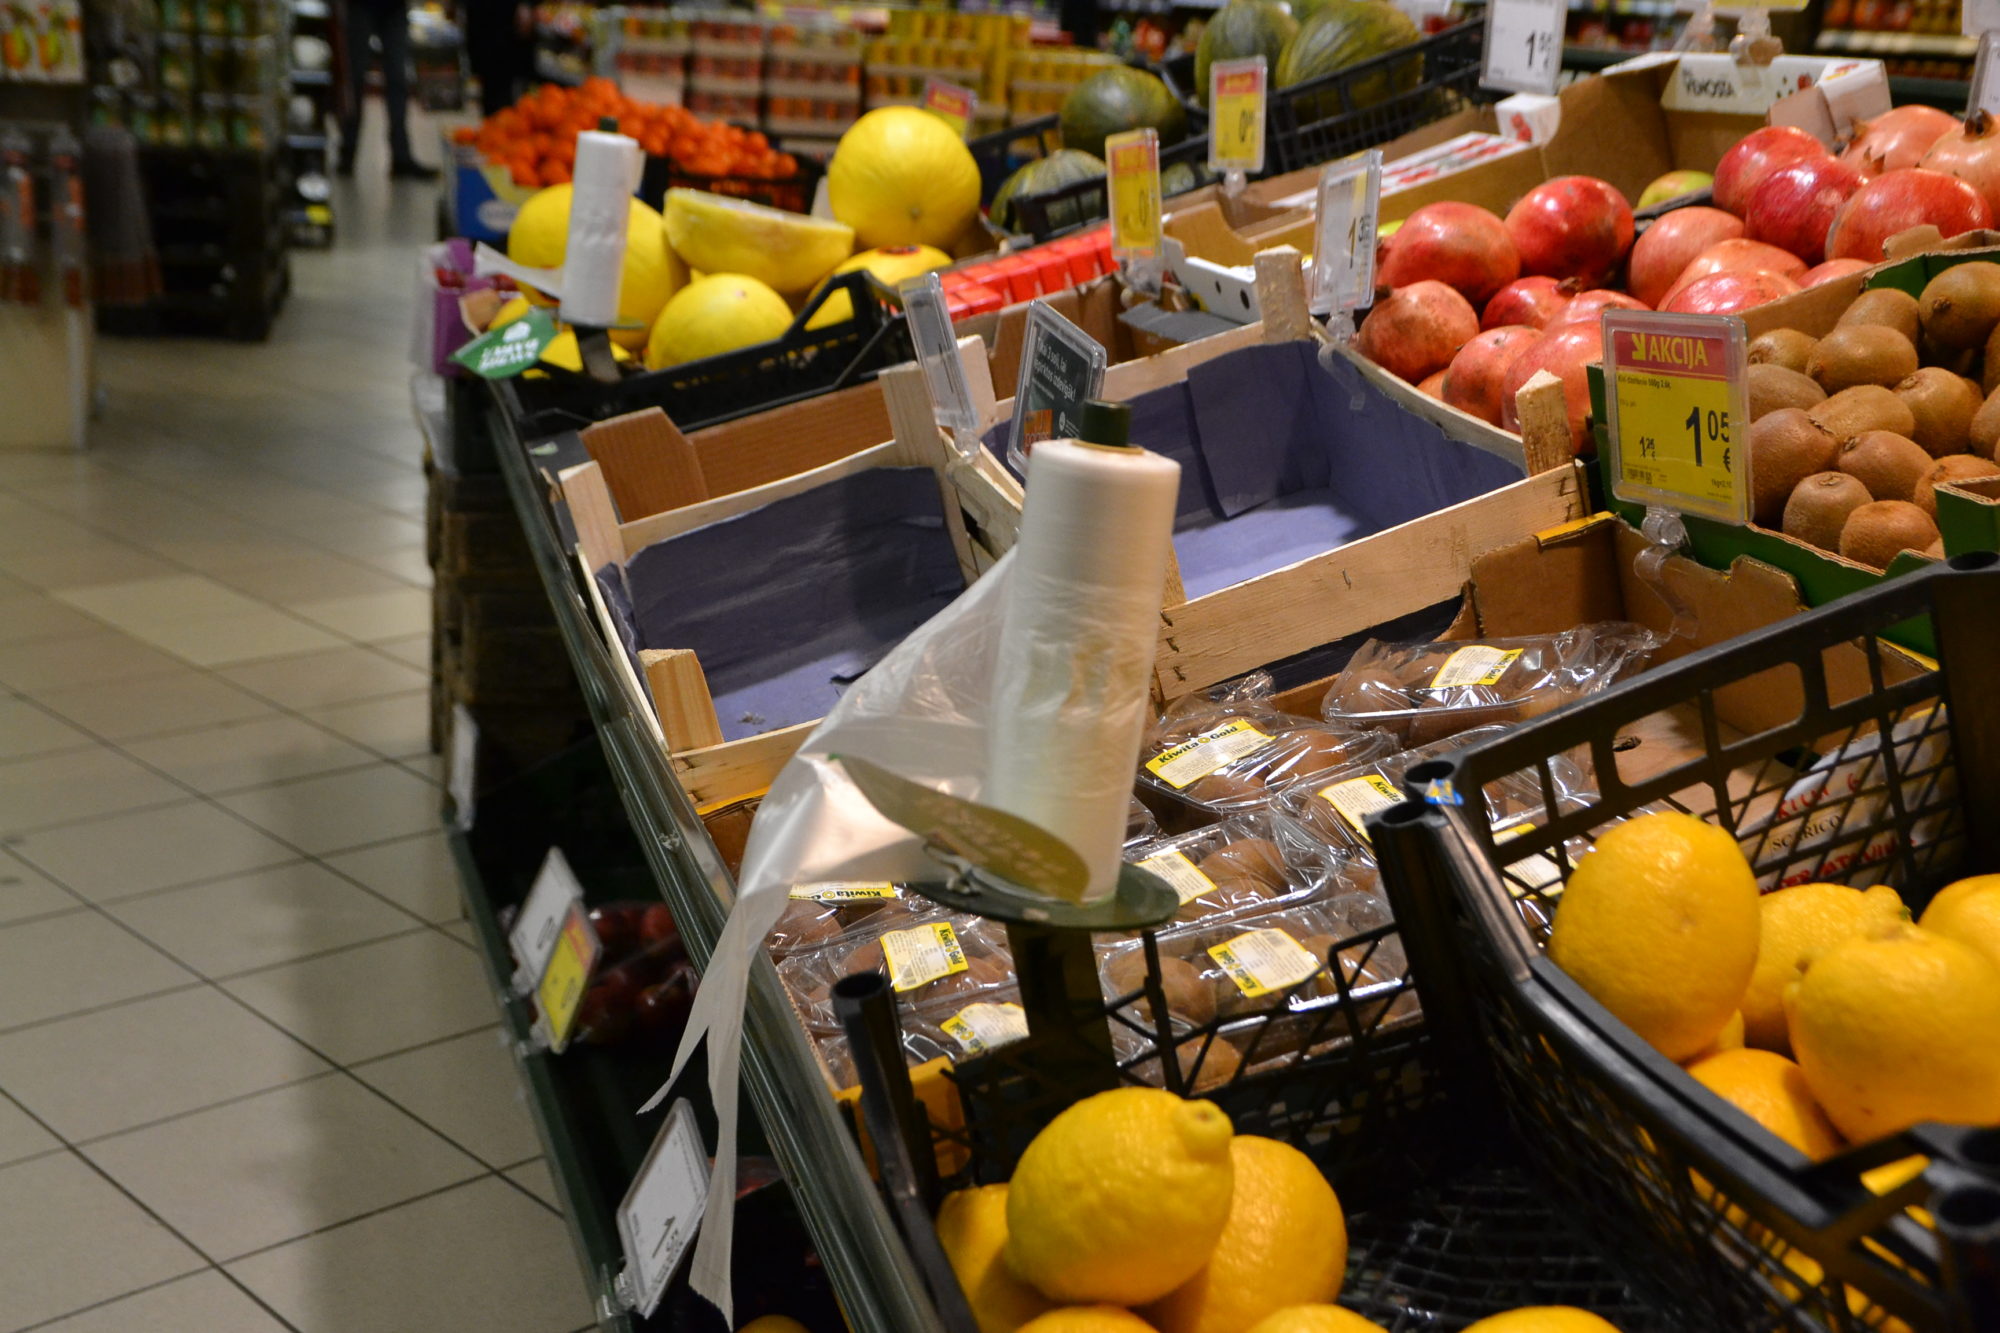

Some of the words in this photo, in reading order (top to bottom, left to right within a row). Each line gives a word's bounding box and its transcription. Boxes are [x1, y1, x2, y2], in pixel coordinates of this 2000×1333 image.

[1649, 335, 1709, 369] AKCIJA
[1707, 410, 1730, 443] 05
[1158, 740, 1200, 764] Kiwita
[1210, 726, 1239, 740] Gold
[1373, 780, 1402, 802] Kiwita
[1772, 815, 1843, 850] SCRICO
[836, 890, 882, 898] Kiwita
